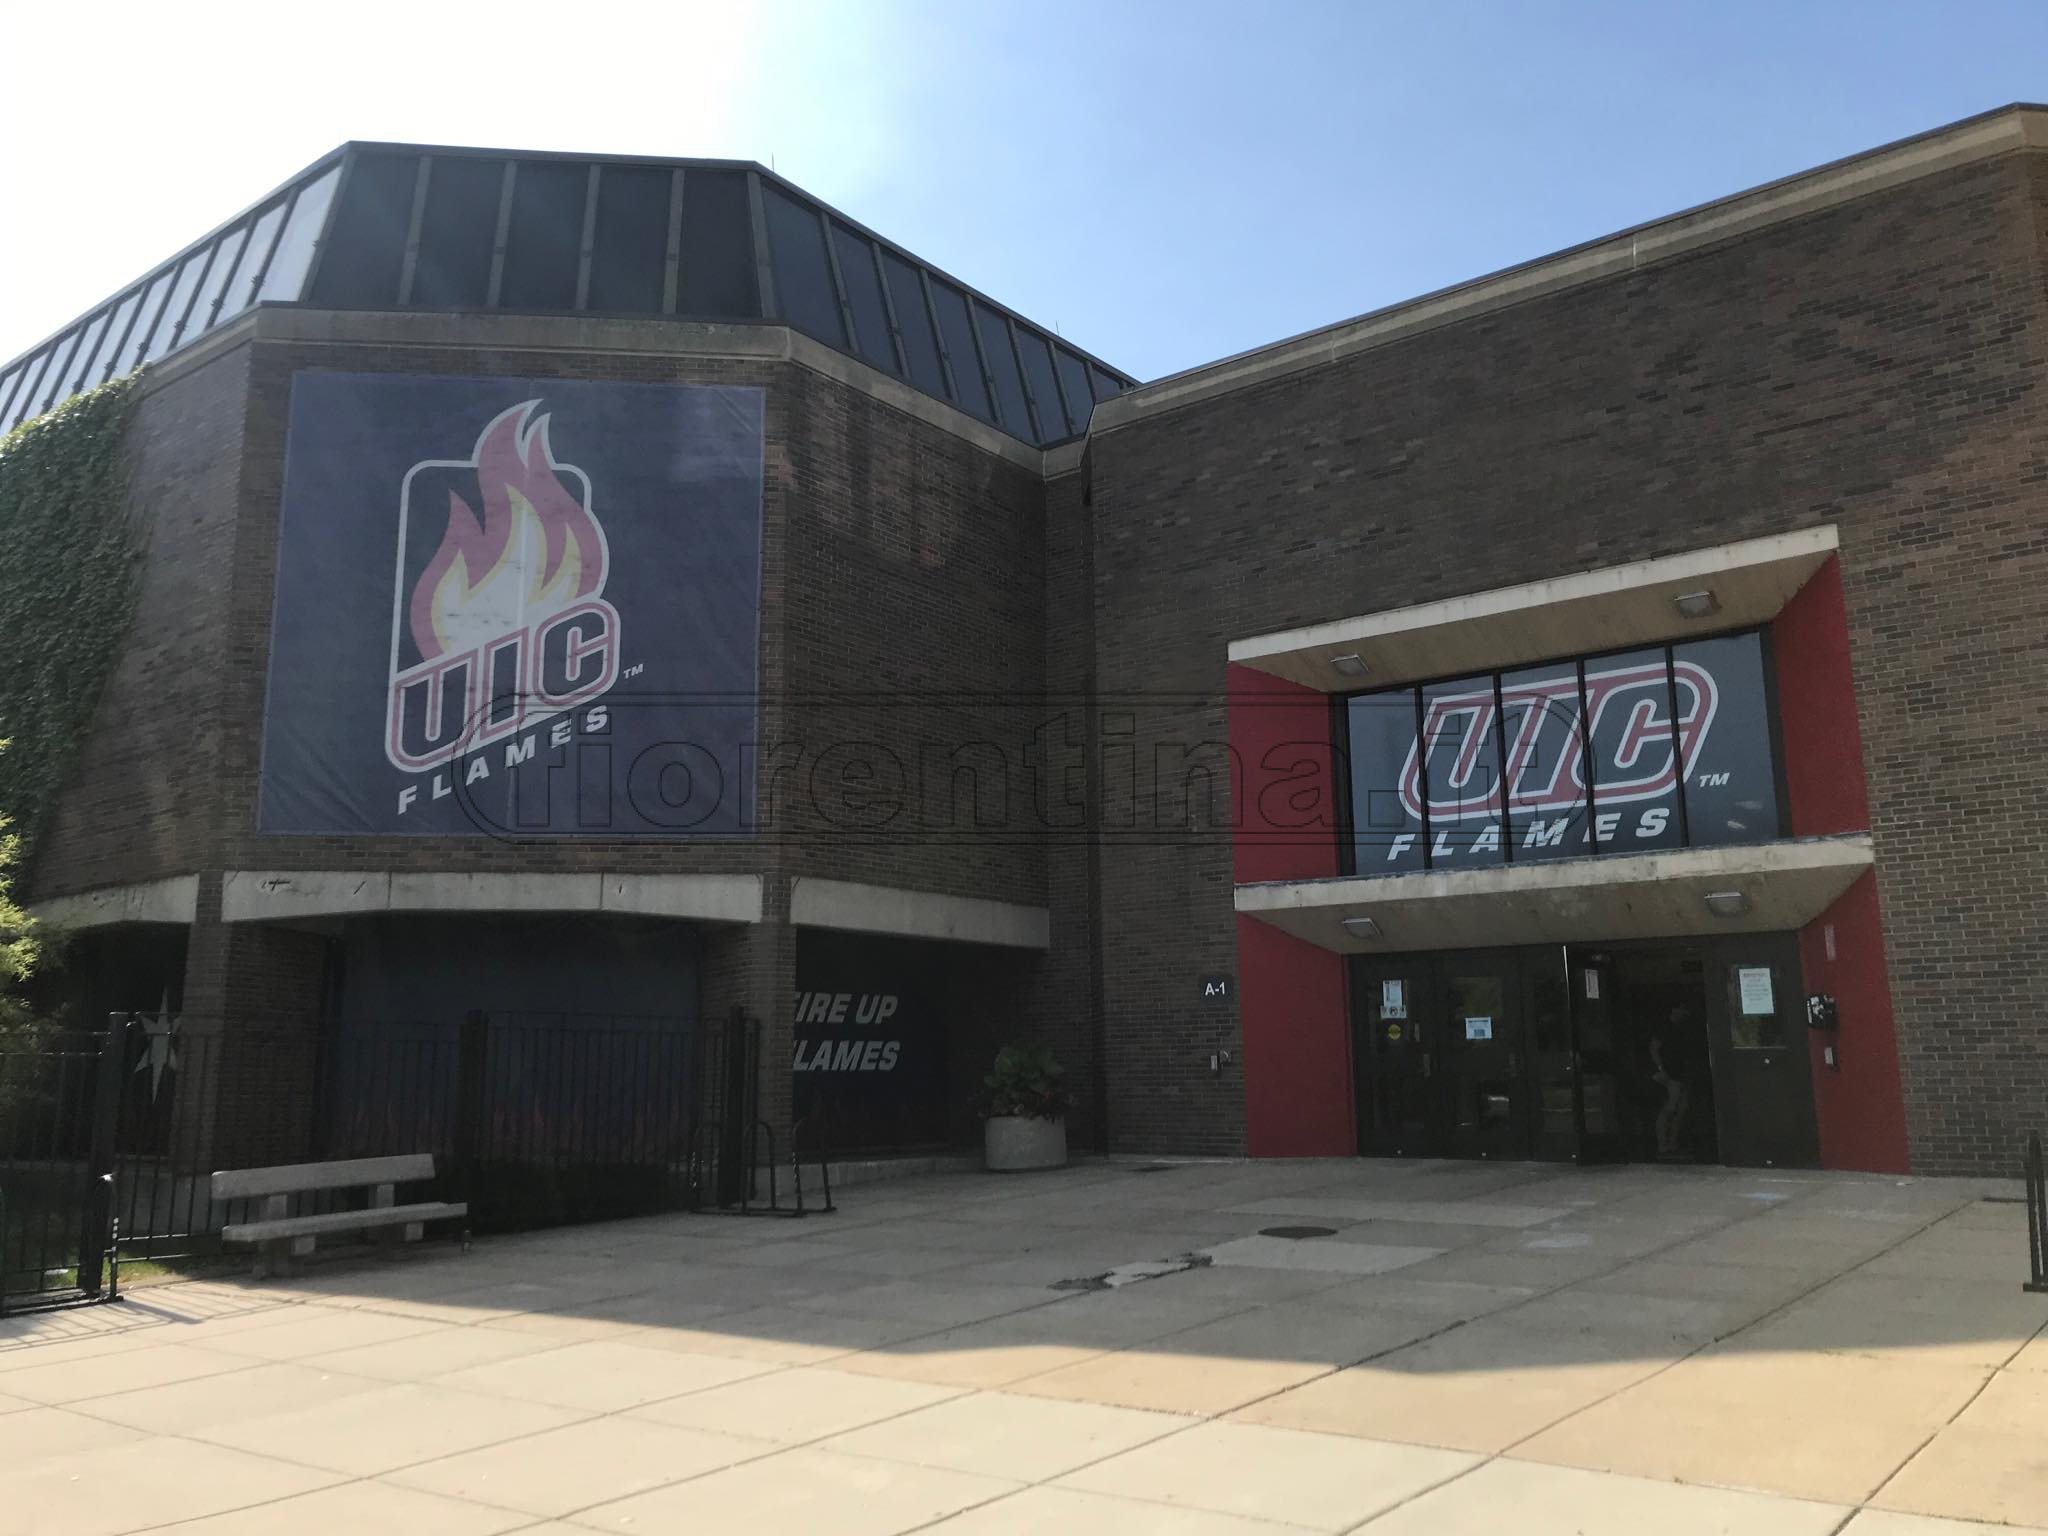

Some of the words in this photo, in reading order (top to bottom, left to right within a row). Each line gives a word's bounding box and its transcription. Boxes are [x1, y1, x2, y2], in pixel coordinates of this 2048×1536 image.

[385, 598, 621, 773] UIC
[398, 705, 608, 815] FLAMES
[1398, 660, 1719, 822] UIC
[1386, 808, 1670, 862] FLAMES
[795, 991, 852, 1024] IRE
[855, 993, 899, 1025] UP
[1204, 981, 1226, 996] A-1
[792, 1039, 900, 1072] LAMES
